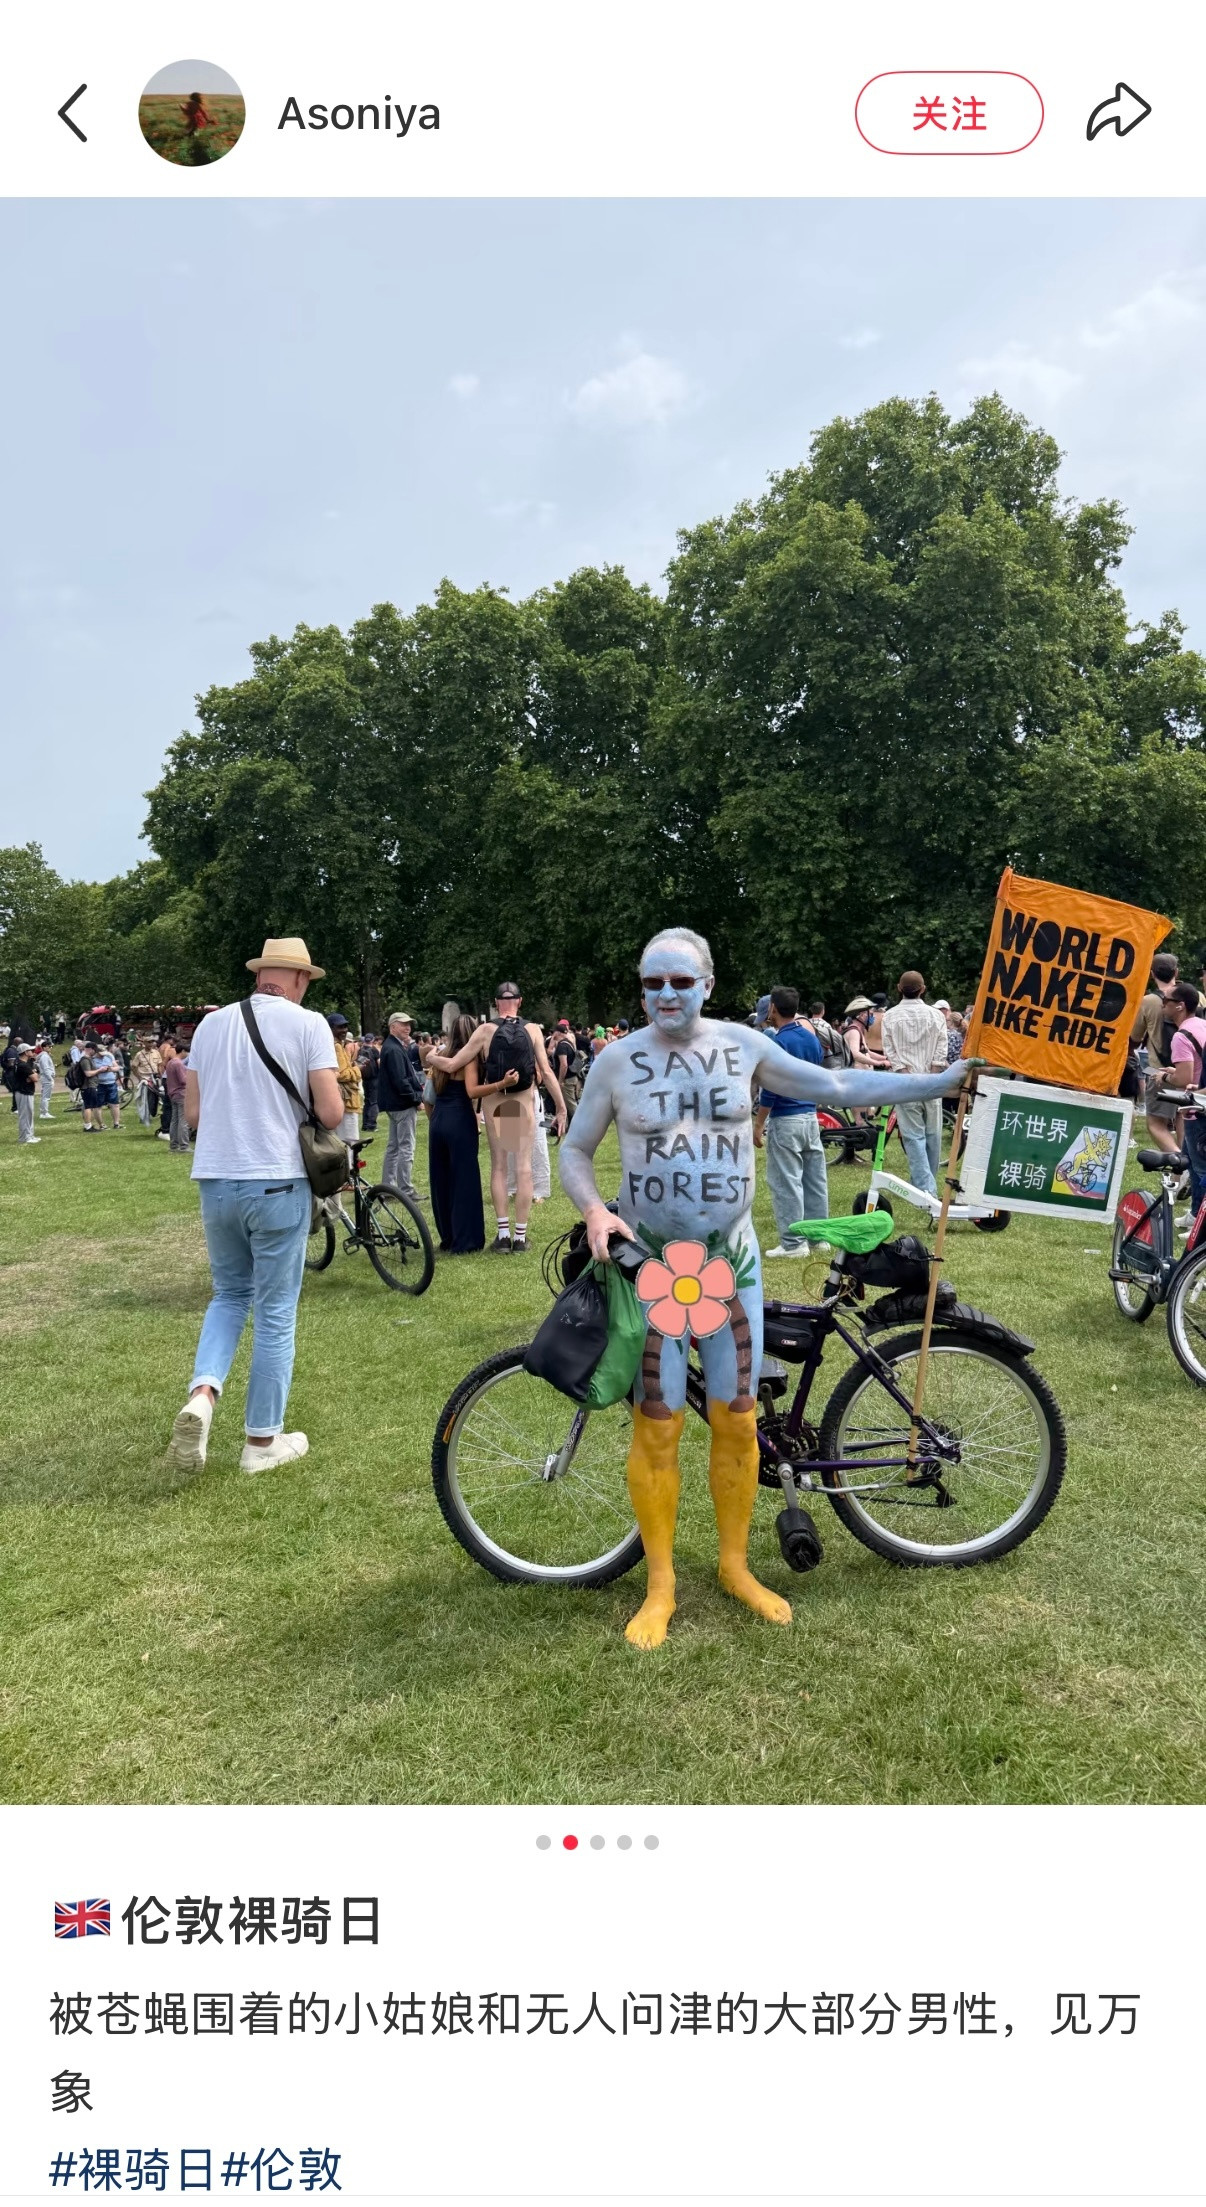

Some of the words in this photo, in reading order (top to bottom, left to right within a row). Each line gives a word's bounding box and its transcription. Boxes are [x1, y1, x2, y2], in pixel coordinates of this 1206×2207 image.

[1001, 908, 1135, 979] WORLD
[988, 951, 1127, 1022] NAKED
[982, 996, 1043, 1038] BIKE
[1048, 1015, 1116, 1055] RIDE
[630, 1046, 742, 1085] SAVE
[650, 1087, 729, 1122] THE
[1000, 1110, 1068, 1143] 环世界
[646, 1134, 739, 1164] RAIN
[628, 1171, 750, 1206] FOREST
[998, 1160, 1047, 1189] 裸骑
